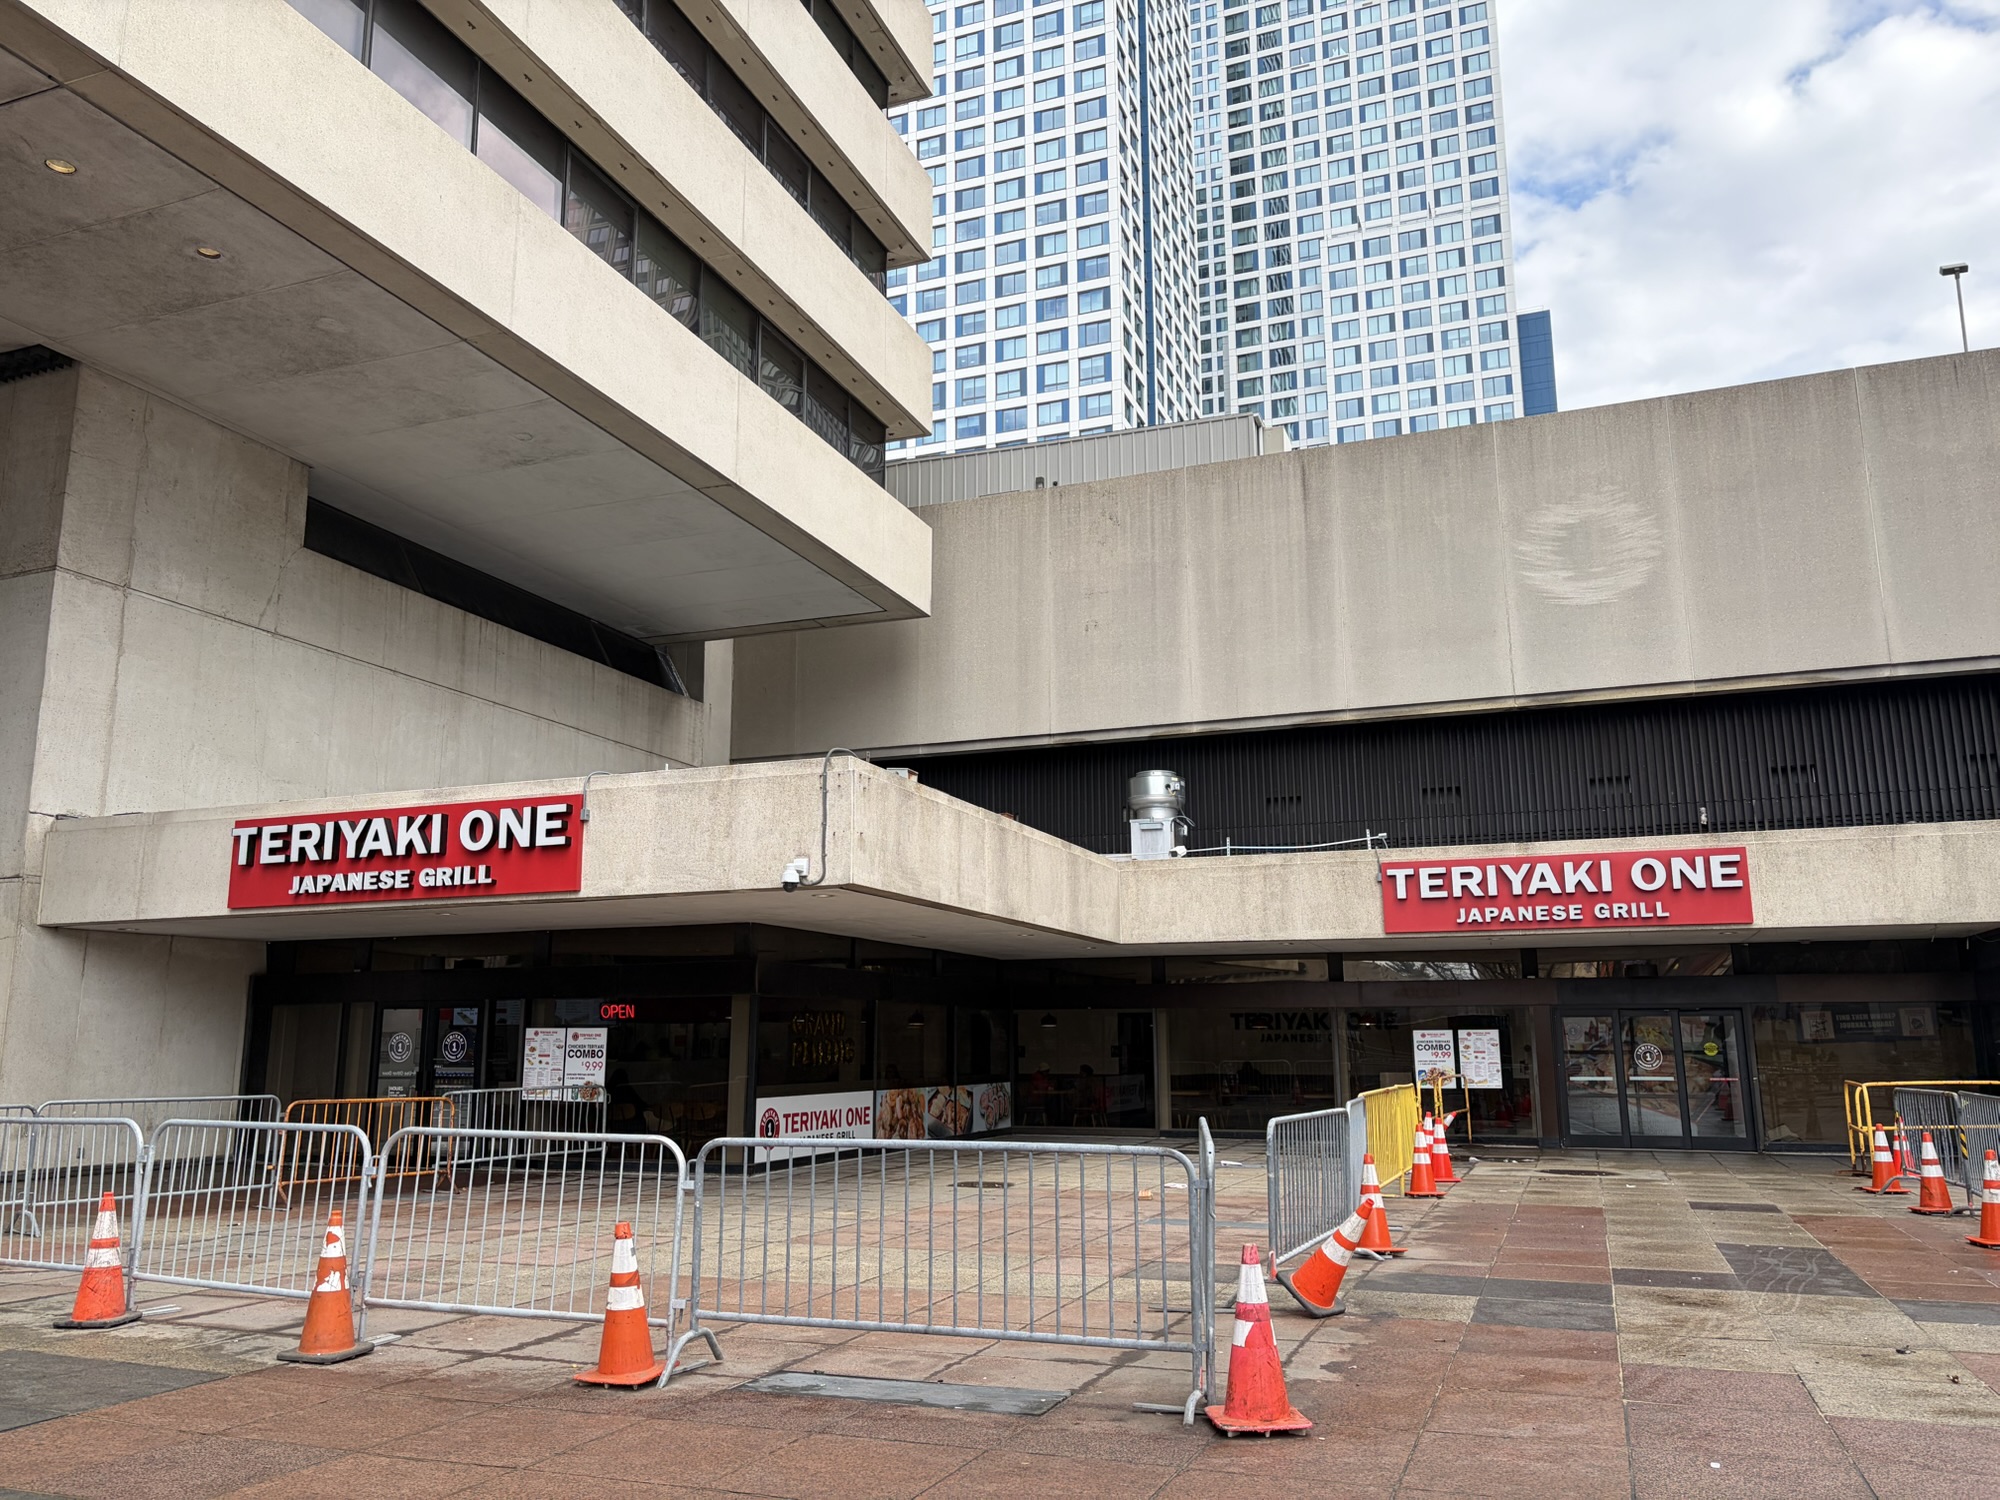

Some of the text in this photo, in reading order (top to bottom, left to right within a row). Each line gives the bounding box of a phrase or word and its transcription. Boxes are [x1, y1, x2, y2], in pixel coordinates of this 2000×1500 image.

[232, 803, 568, 866] TERIYAKI ONE
[288, 864, 493, 895] JAPANESE GRILL
[1386, 854, 1744, 900] TERIYAKI ONE
[1456, 901, 1670, 924] JAPANESE GRILL
[600, 1004, 635, 1019] OPEN
[1230, 1012, 1330, 1030] TERIYAK
[568, 1049, 604, 1058] COMBO
[582, 1061, 604, 1071] $9.99
[762, 1110, 778, 1125] TERIYAKI
[783, 1106, 870, 1134] TERIYAKI ONE
[768, 1122, 772, 1136] 1
